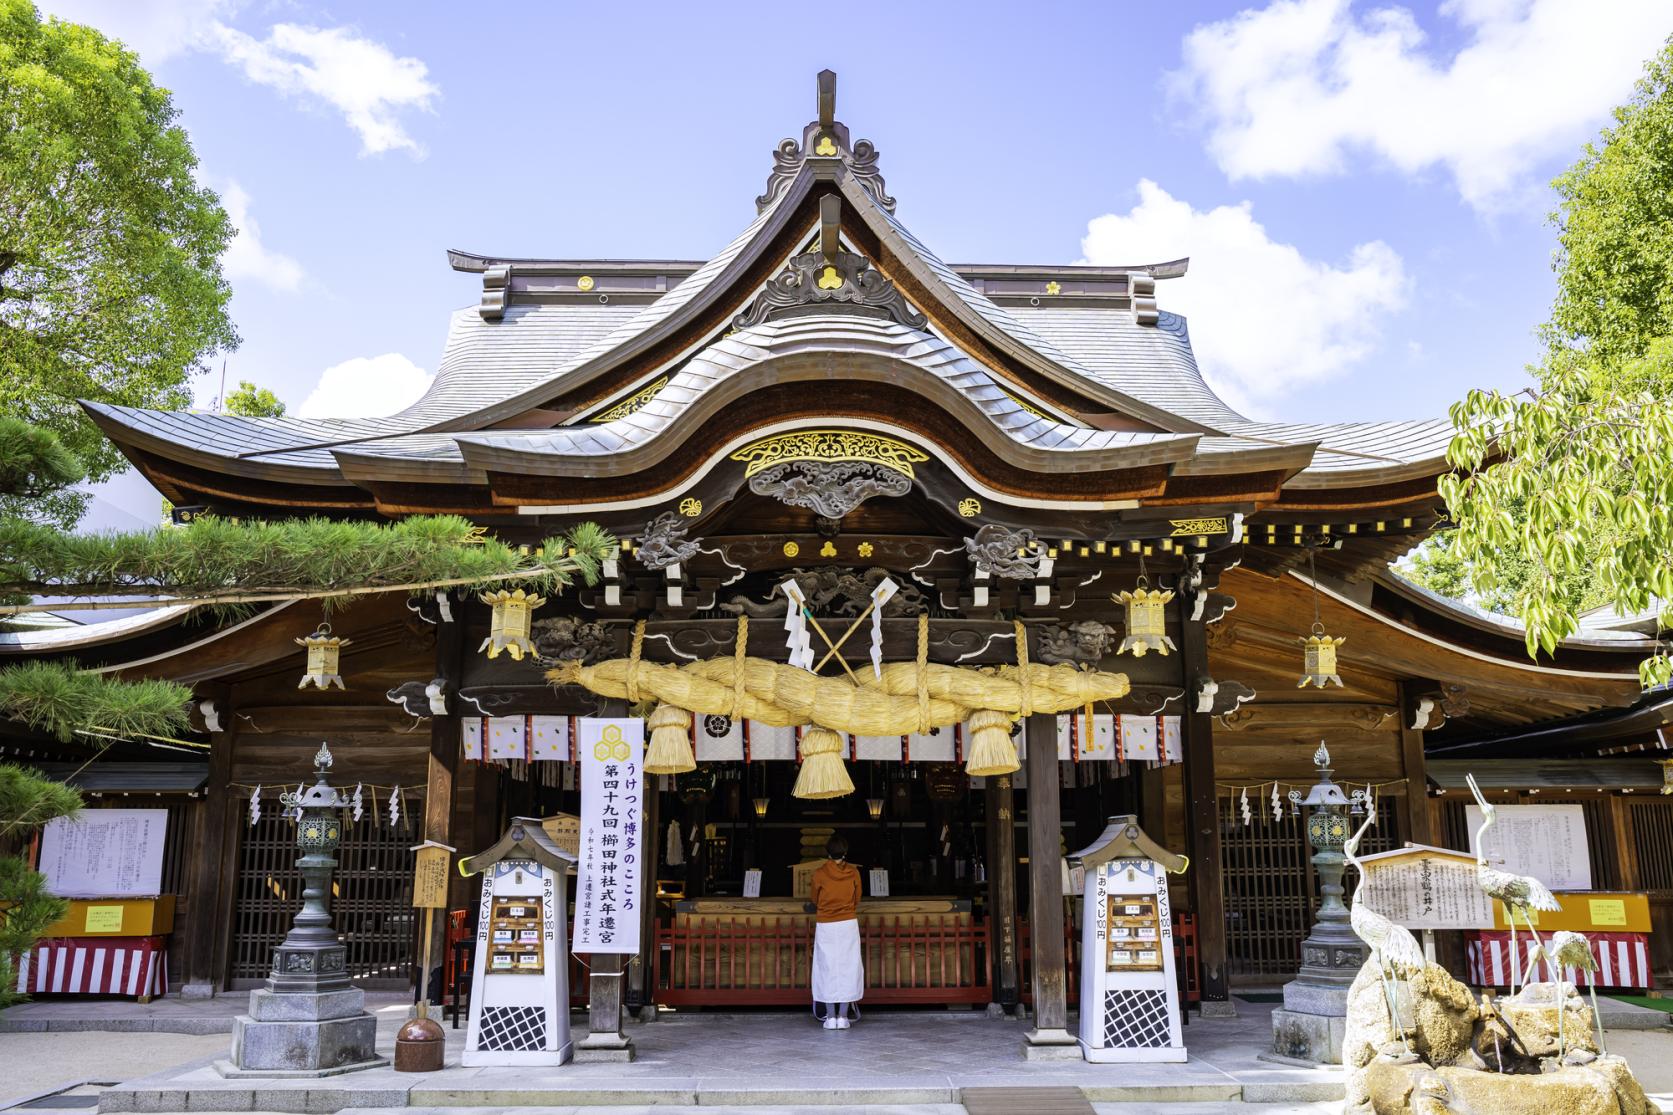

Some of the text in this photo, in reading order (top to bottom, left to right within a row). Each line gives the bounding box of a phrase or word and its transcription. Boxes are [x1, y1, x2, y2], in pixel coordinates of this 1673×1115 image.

[623, 763, 637, 910] うけつぐ博多のこころ
